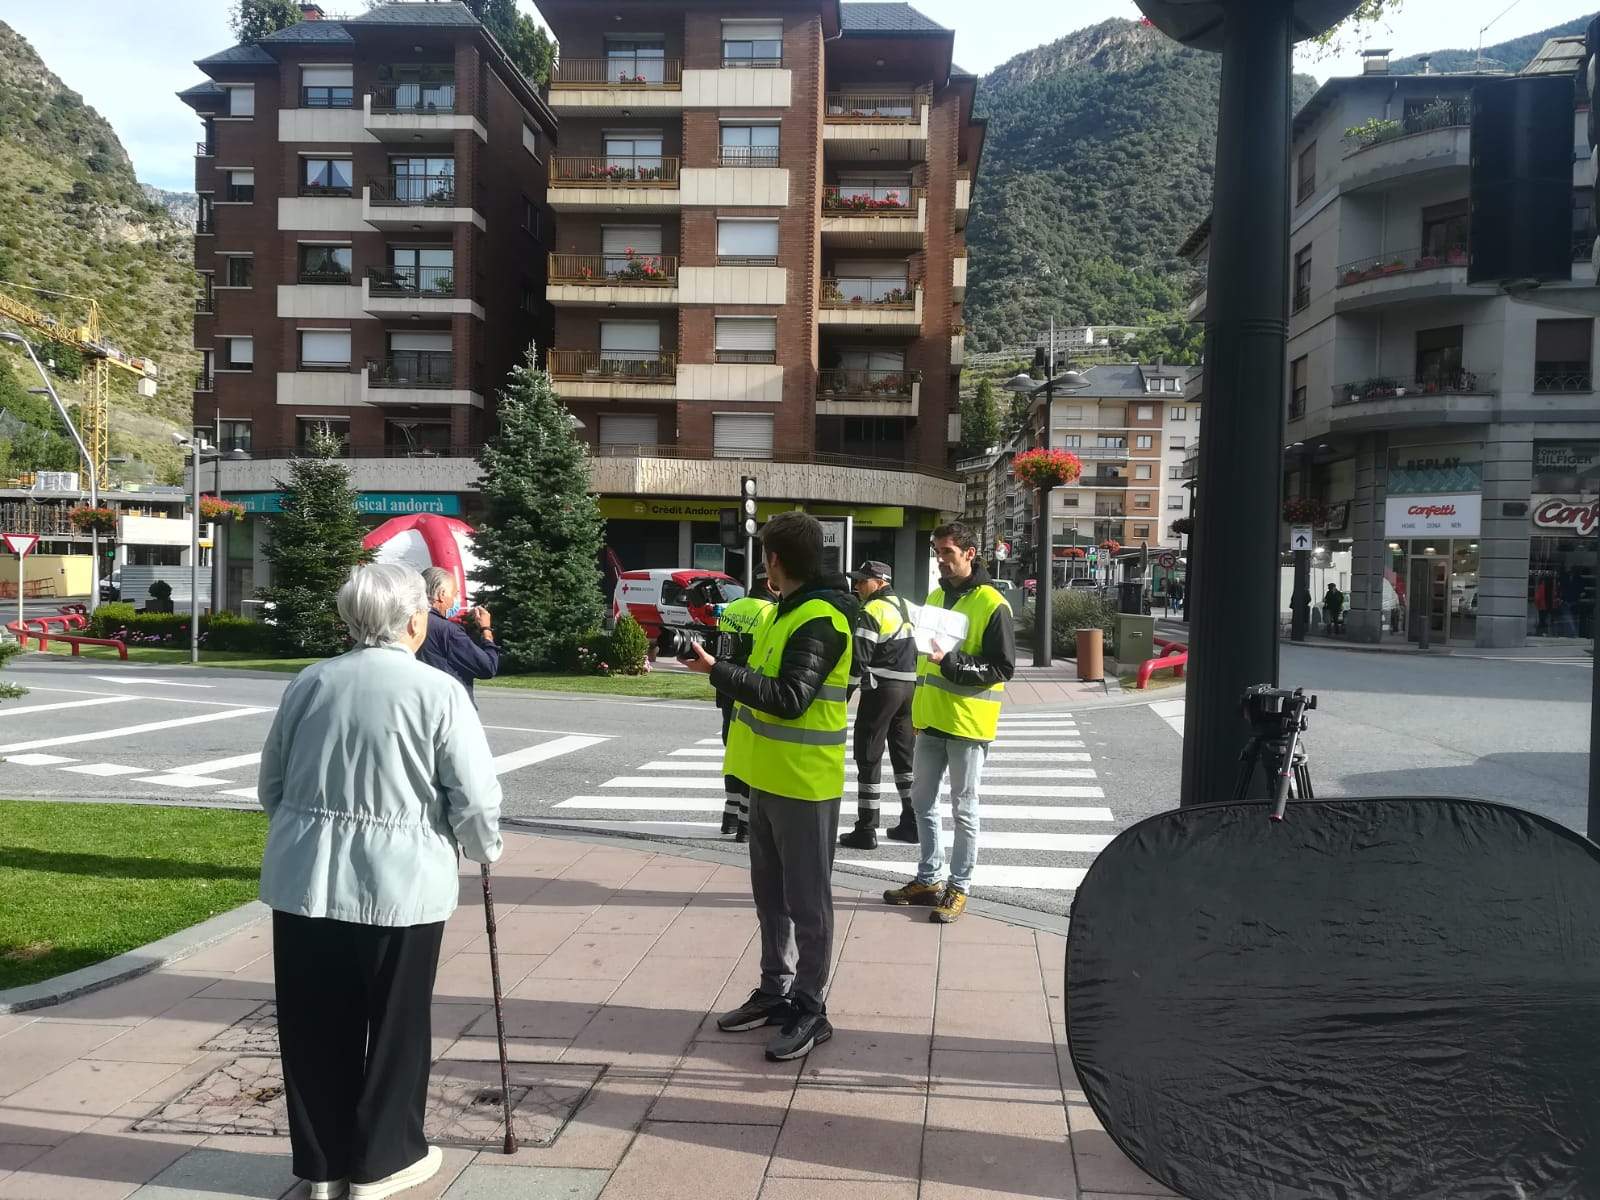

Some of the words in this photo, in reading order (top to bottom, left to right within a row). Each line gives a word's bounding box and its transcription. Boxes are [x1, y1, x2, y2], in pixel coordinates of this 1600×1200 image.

[1407, 457, 1460, 471] REPLAY
[1535, 455, 1592, 465] HILFIGER
[351, 497, 386, 512] usical
[390, 497, 444, 512] andorrà
[1407, 504, 1457, 519] Confetti
